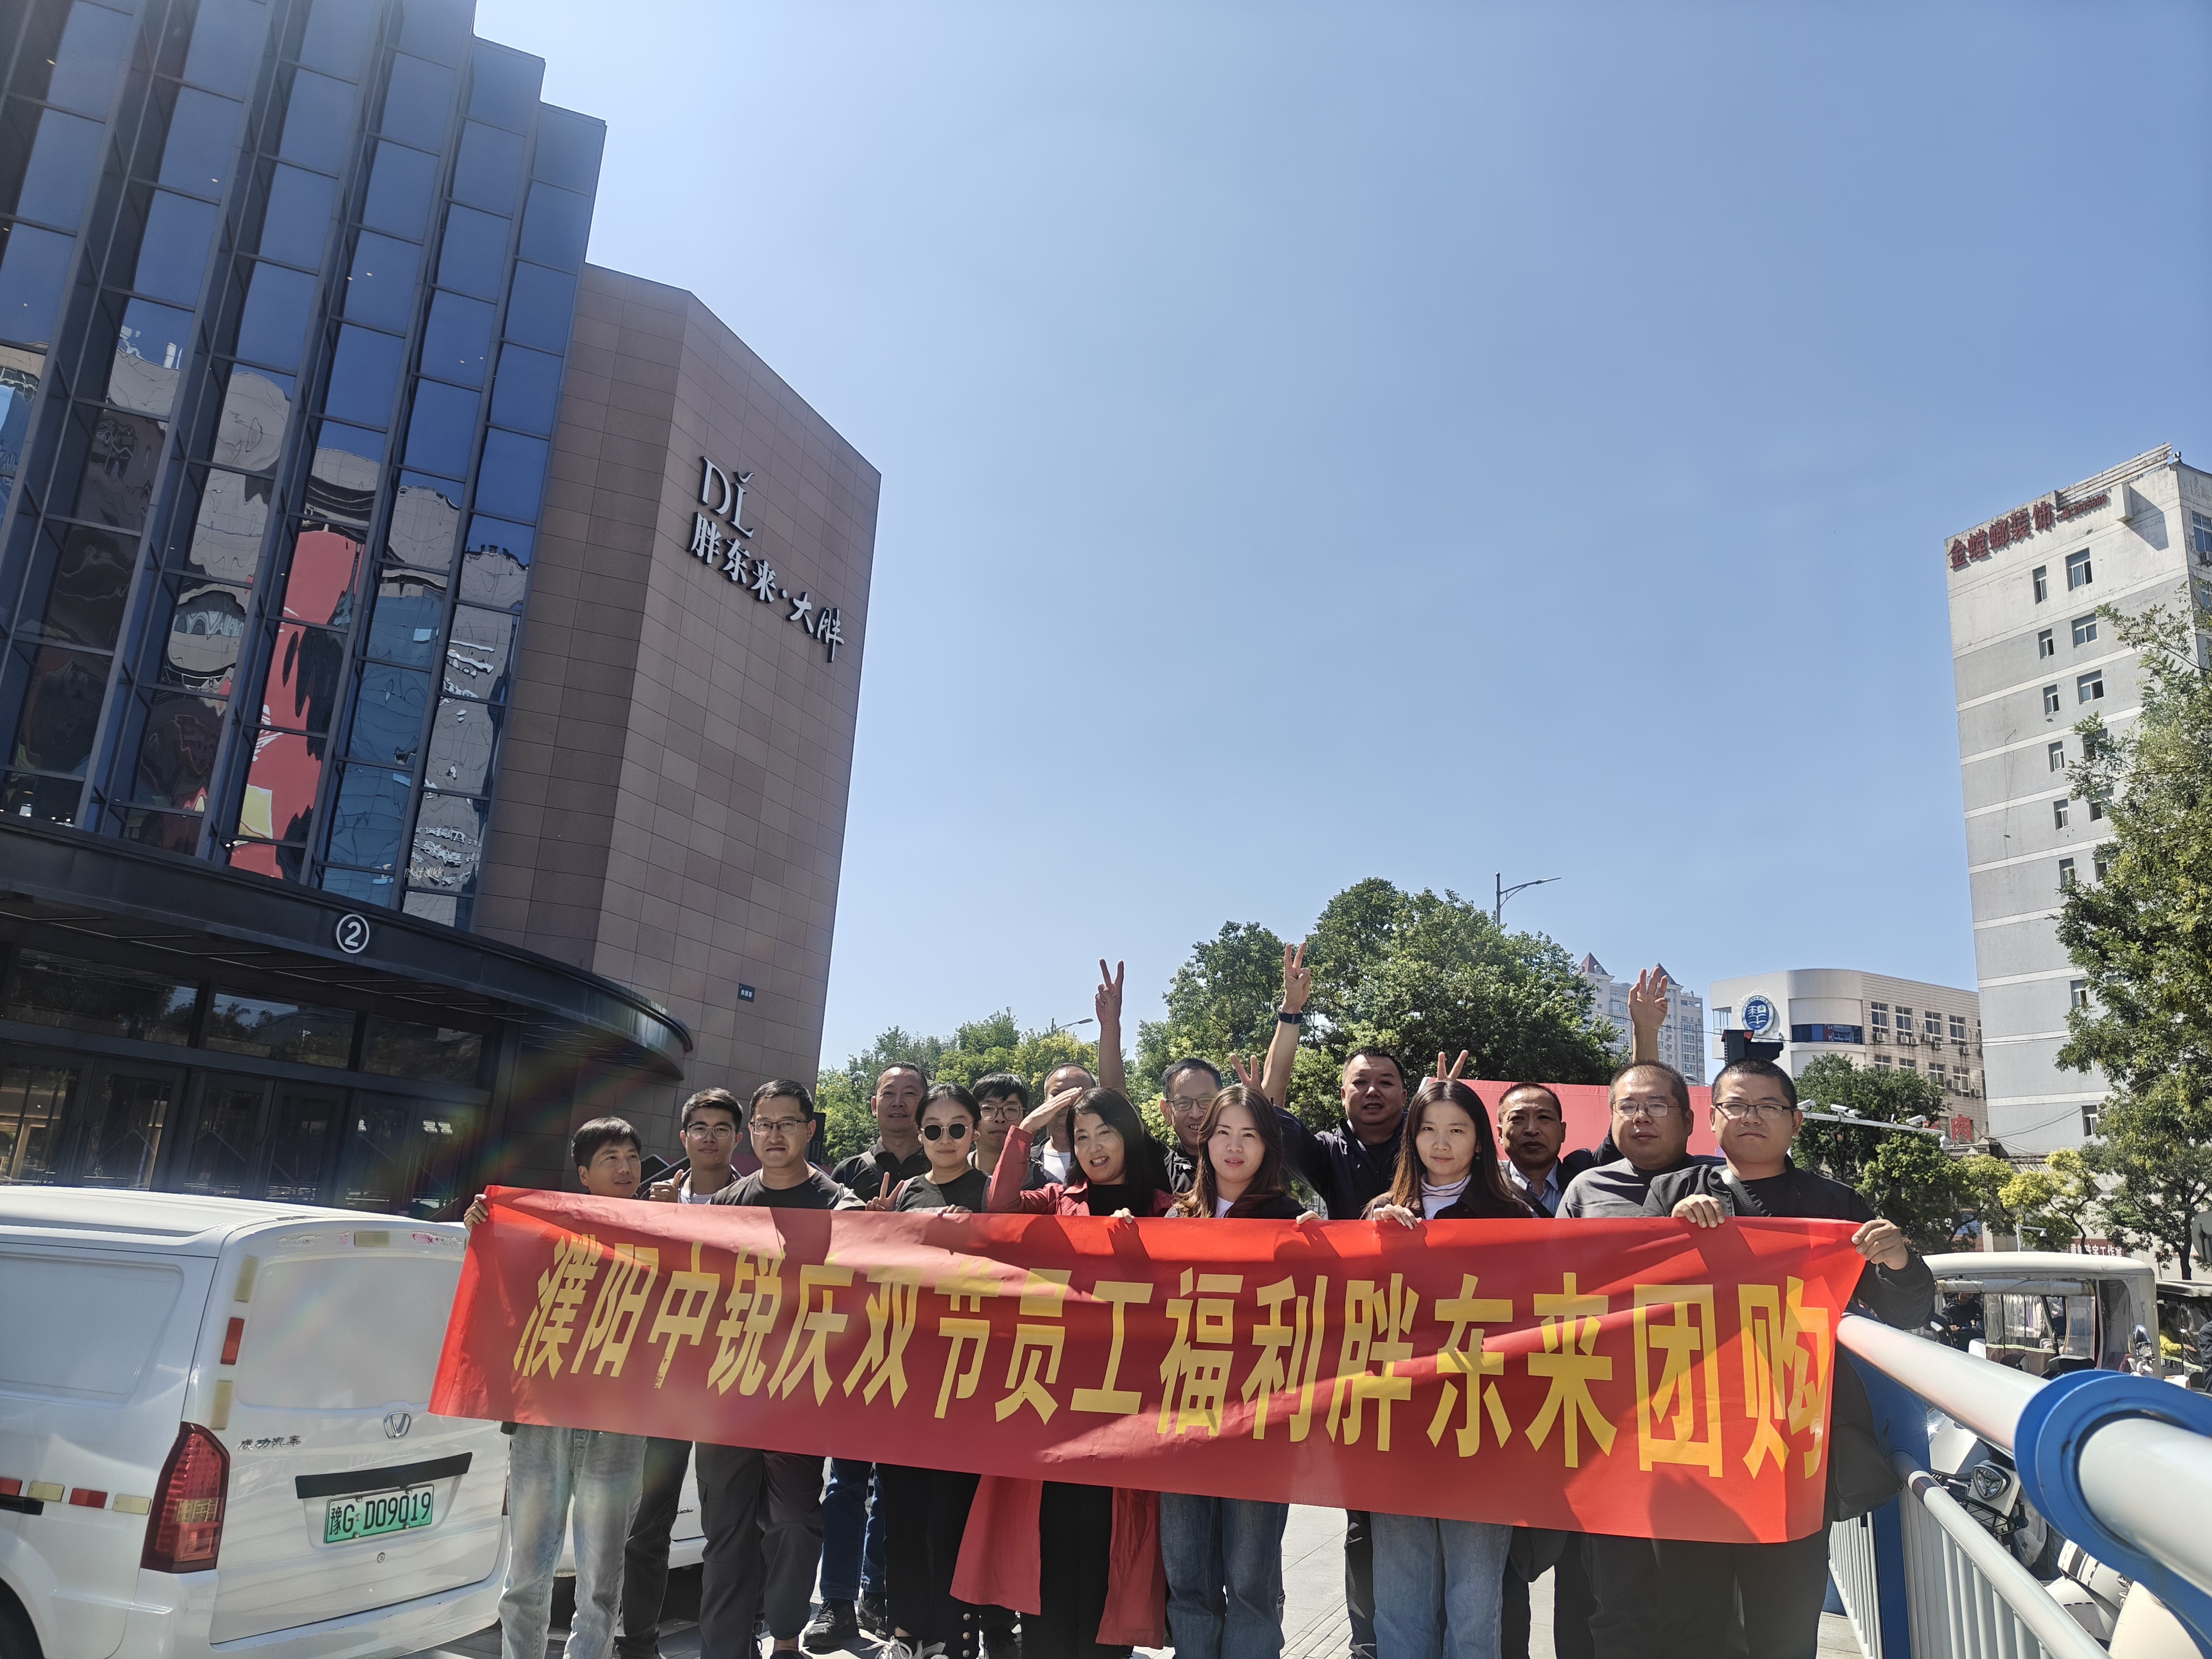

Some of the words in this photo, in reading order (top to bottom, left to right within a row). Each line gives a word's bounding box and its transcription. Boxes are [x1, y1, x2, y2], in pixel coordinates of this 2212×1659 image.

[1947, 501, 2052, 569] 金螳螂装饰
[345, 921, 361, 947] 2
[513, 1234, 1831, 1480] 濮阳中锐庆双节员工福利胖东来团购
[238, 1435, 301, 1451] 成功汽车
